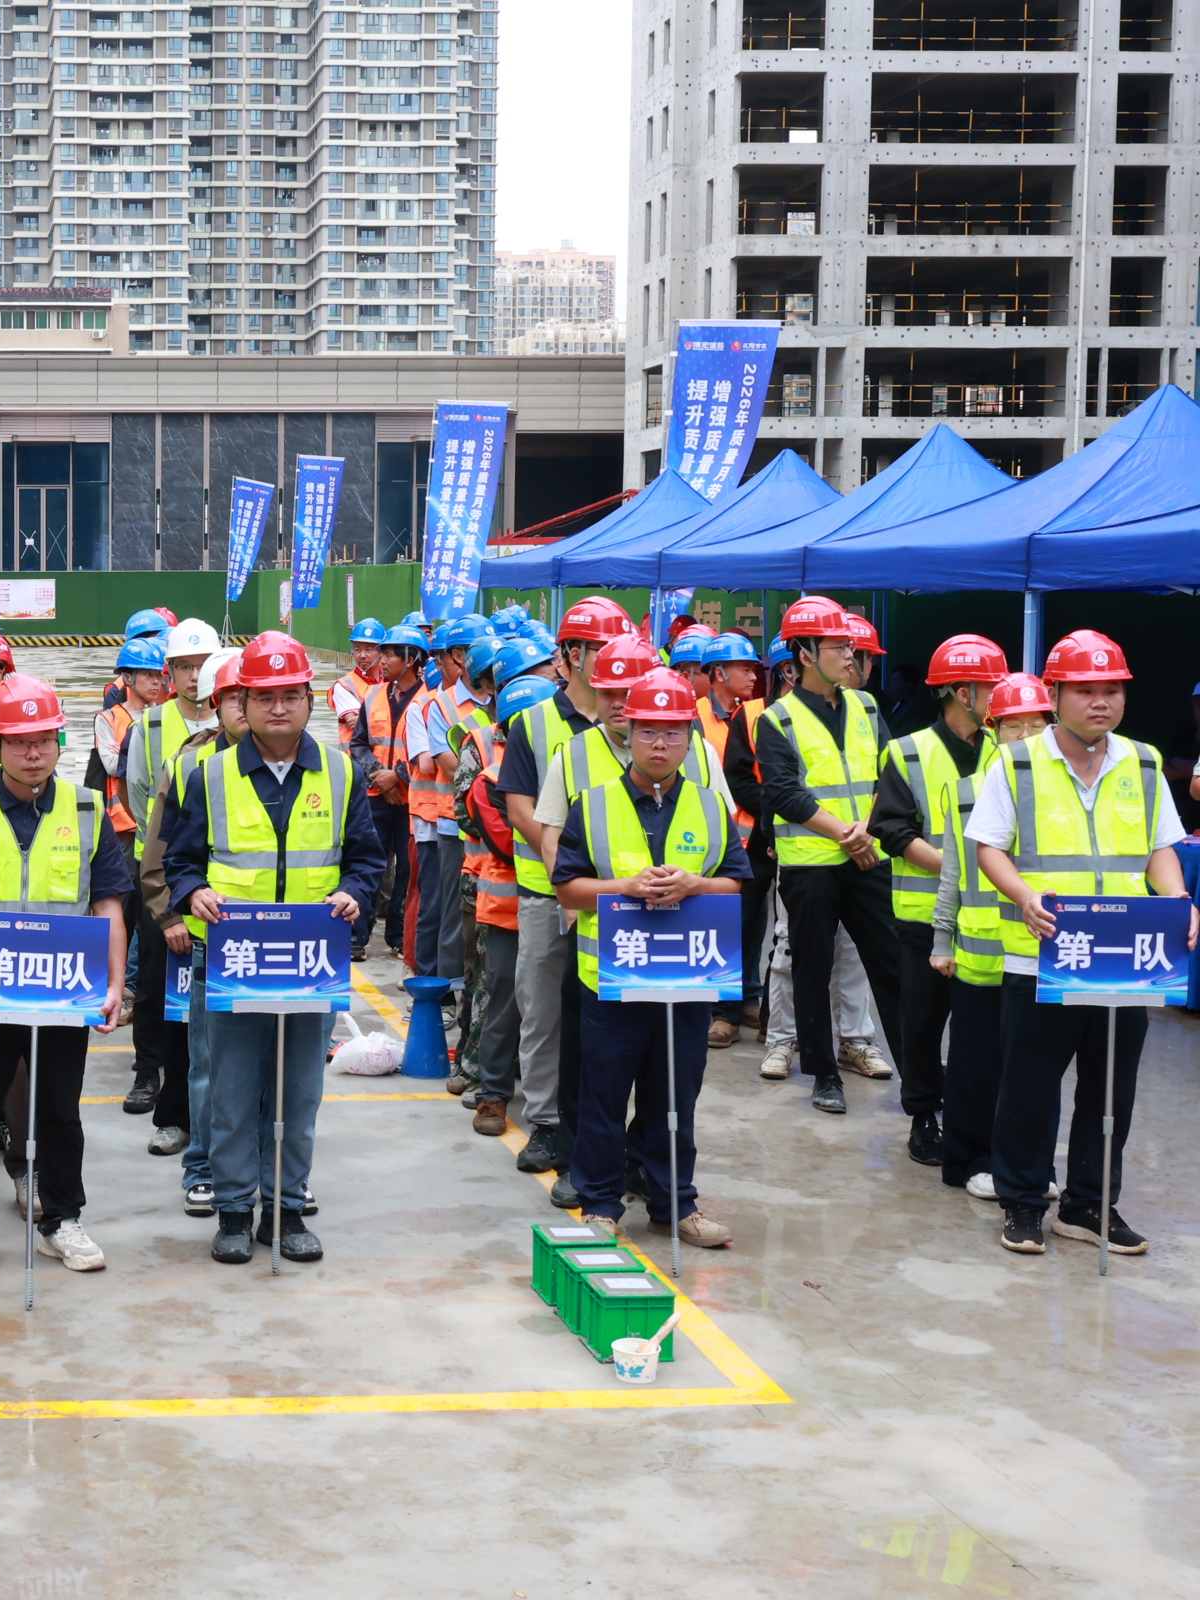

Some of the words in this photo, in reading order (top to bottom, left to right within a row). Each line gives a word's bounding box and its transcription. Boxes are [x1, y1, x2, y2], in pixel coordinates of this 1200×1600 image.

[704, 363, 758, 500] 2026年质量月劳
[436, 439, 477, 596] 增强质量技术基础能力
[452, 429, 495, 608] 2026年质量月劳动技能比武大赛
[221, 938, 337, 979] 第三队
[612, 928, 728, 968] 第二队
[1053, 930, 1174, 972] 第一队
